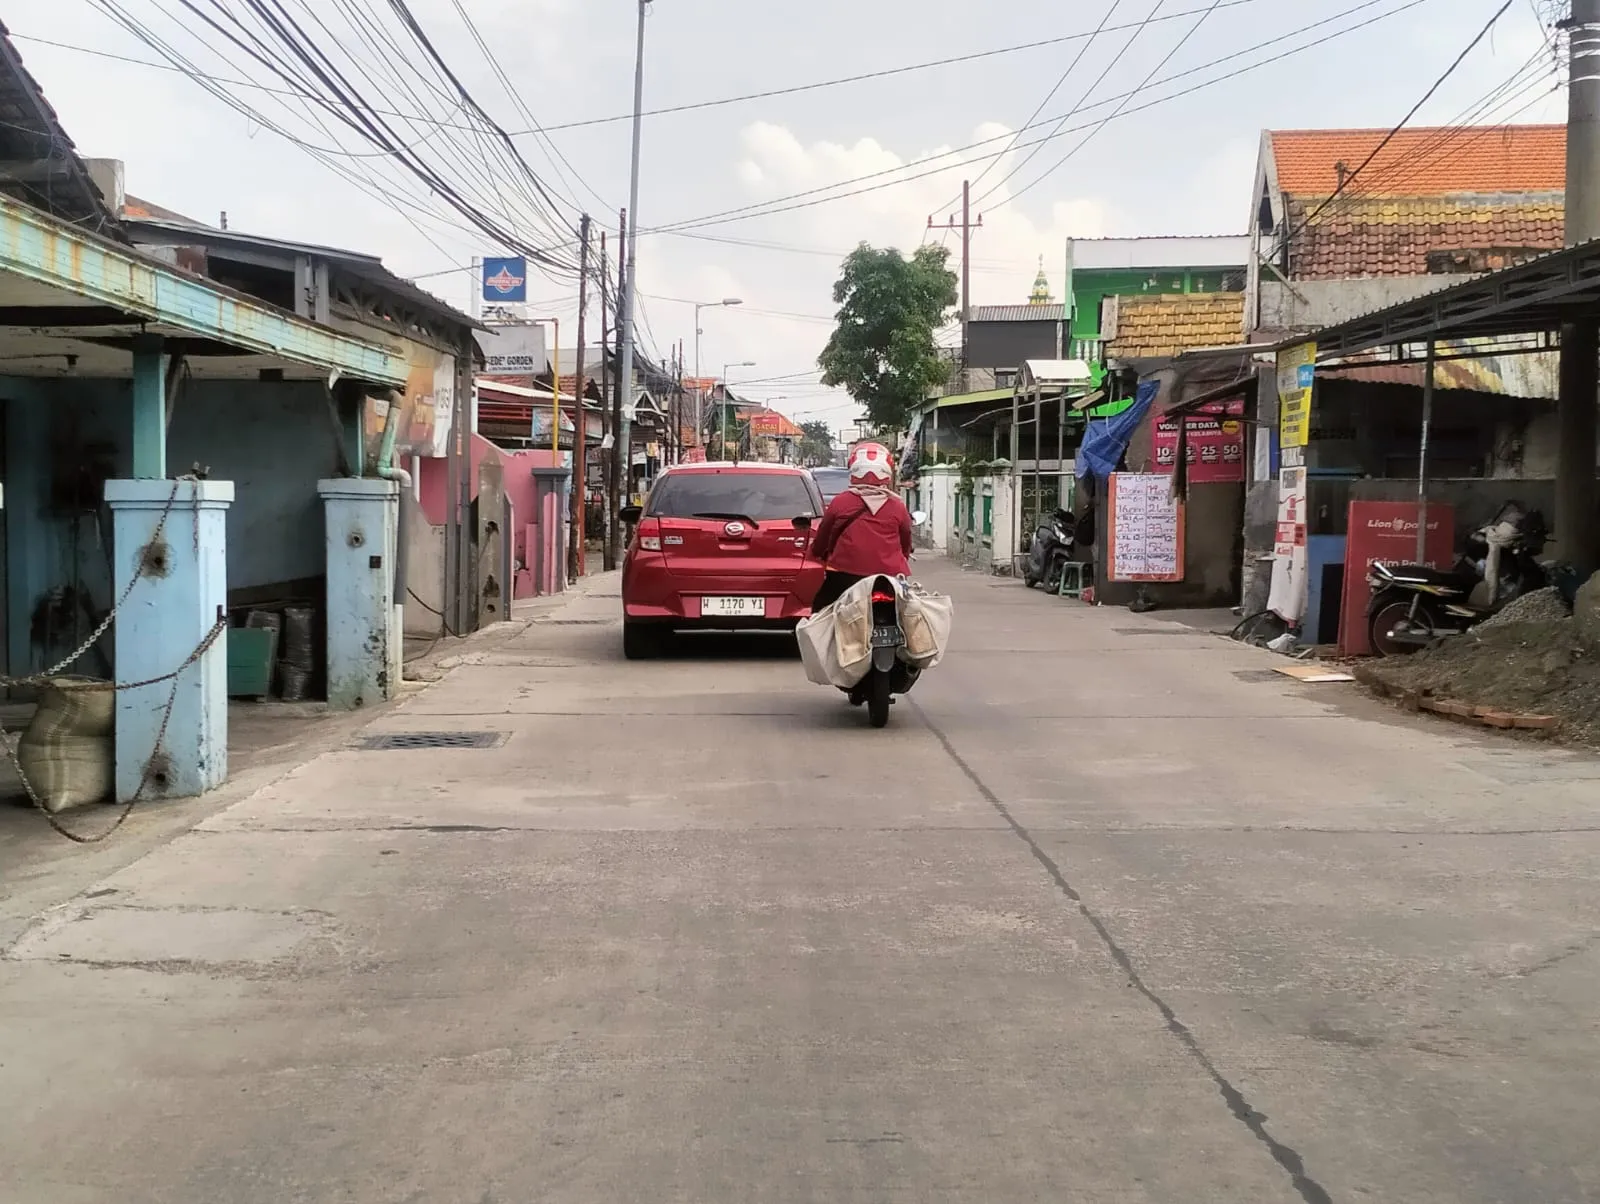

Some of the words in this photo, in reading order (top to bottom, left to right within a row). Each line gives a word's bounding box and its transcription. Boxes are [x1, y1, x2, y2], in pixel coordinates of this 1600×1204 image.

[1156, 447, 1170, 456] 10
[1202, 446, 1216, 455] 25
[1223, 445, 1238, 454] 50
[1367, 519, 1392, 528] Lion
[1404, 521, 1439, 530] pael
[703, 599, 709, 608] W
[720, 599, 744, 609] 1170
[751, 599, 763, 609] YI
